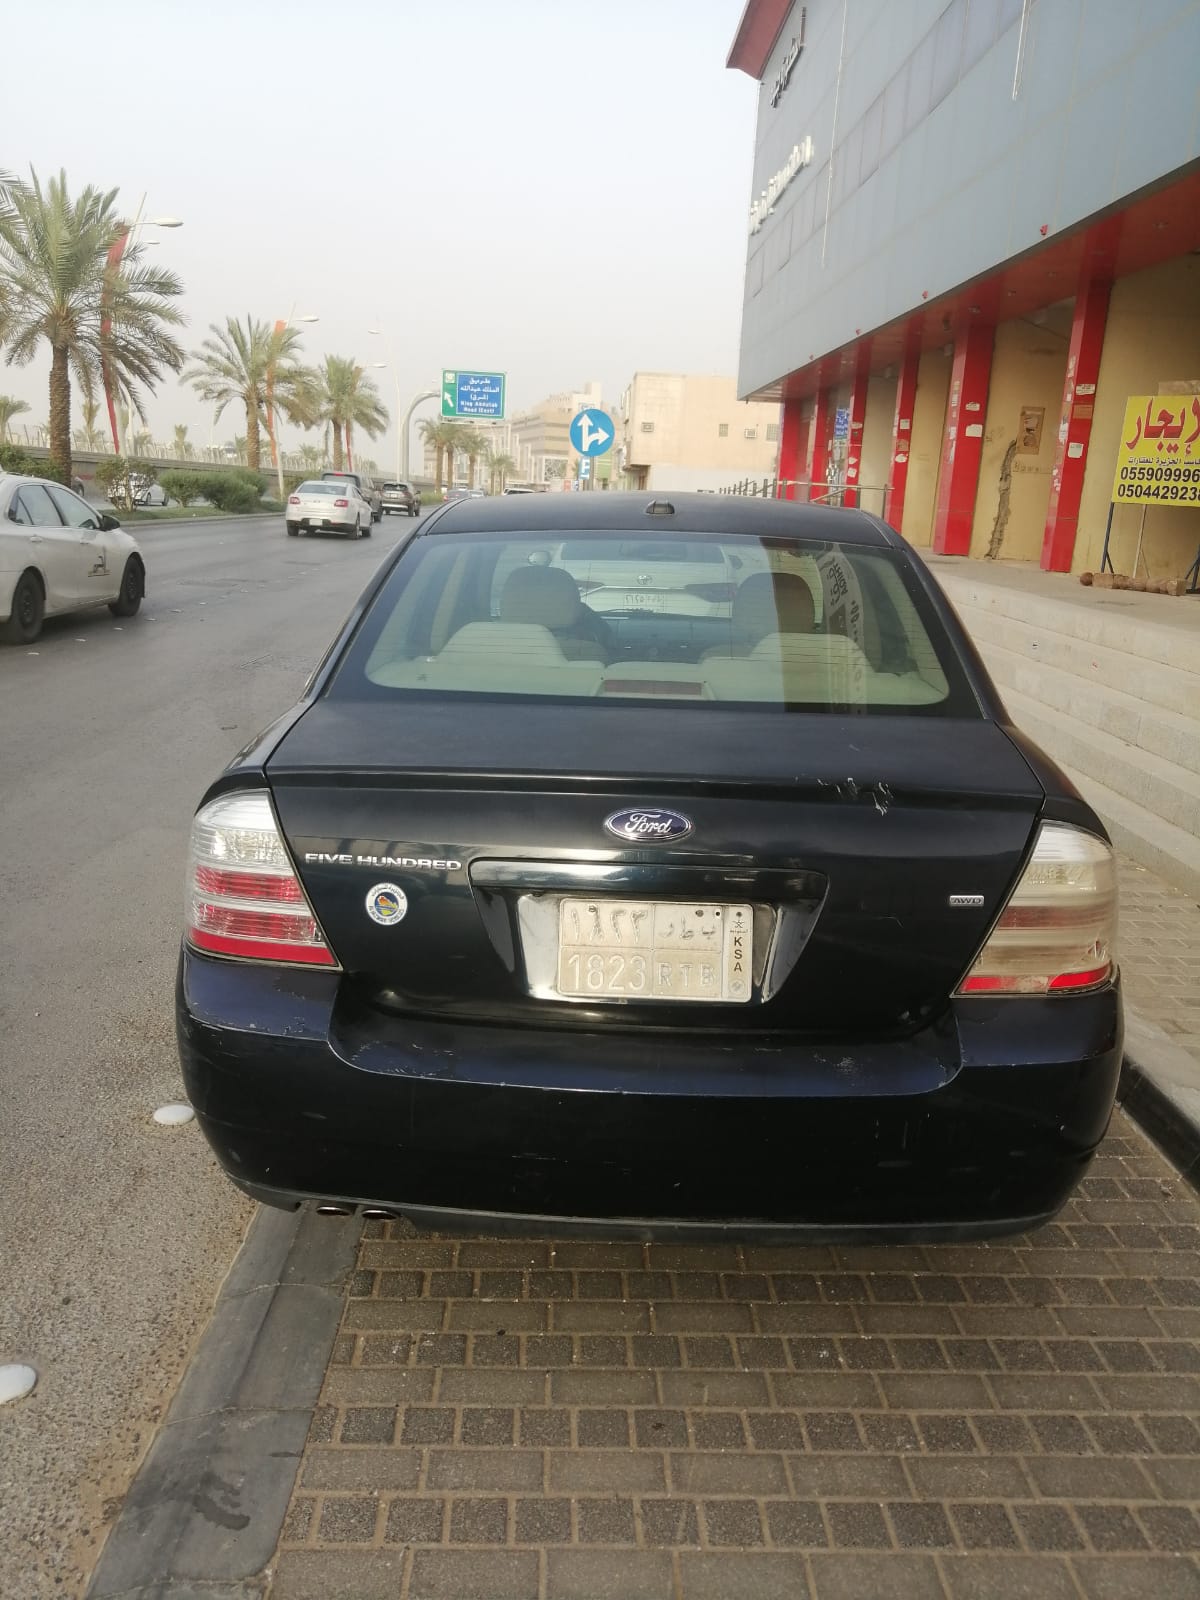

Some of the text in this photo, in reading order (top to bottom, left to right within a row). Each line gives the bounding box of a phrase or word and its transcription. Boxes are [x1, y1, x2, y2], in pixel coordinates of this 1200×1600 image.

[1118, 483, 1200, 500] 050442923
[624, 812, 673, 833] Ford
[305, 853, 462, 871] FIVE HUNDRED
[568, 954, 646, 991] 1823
